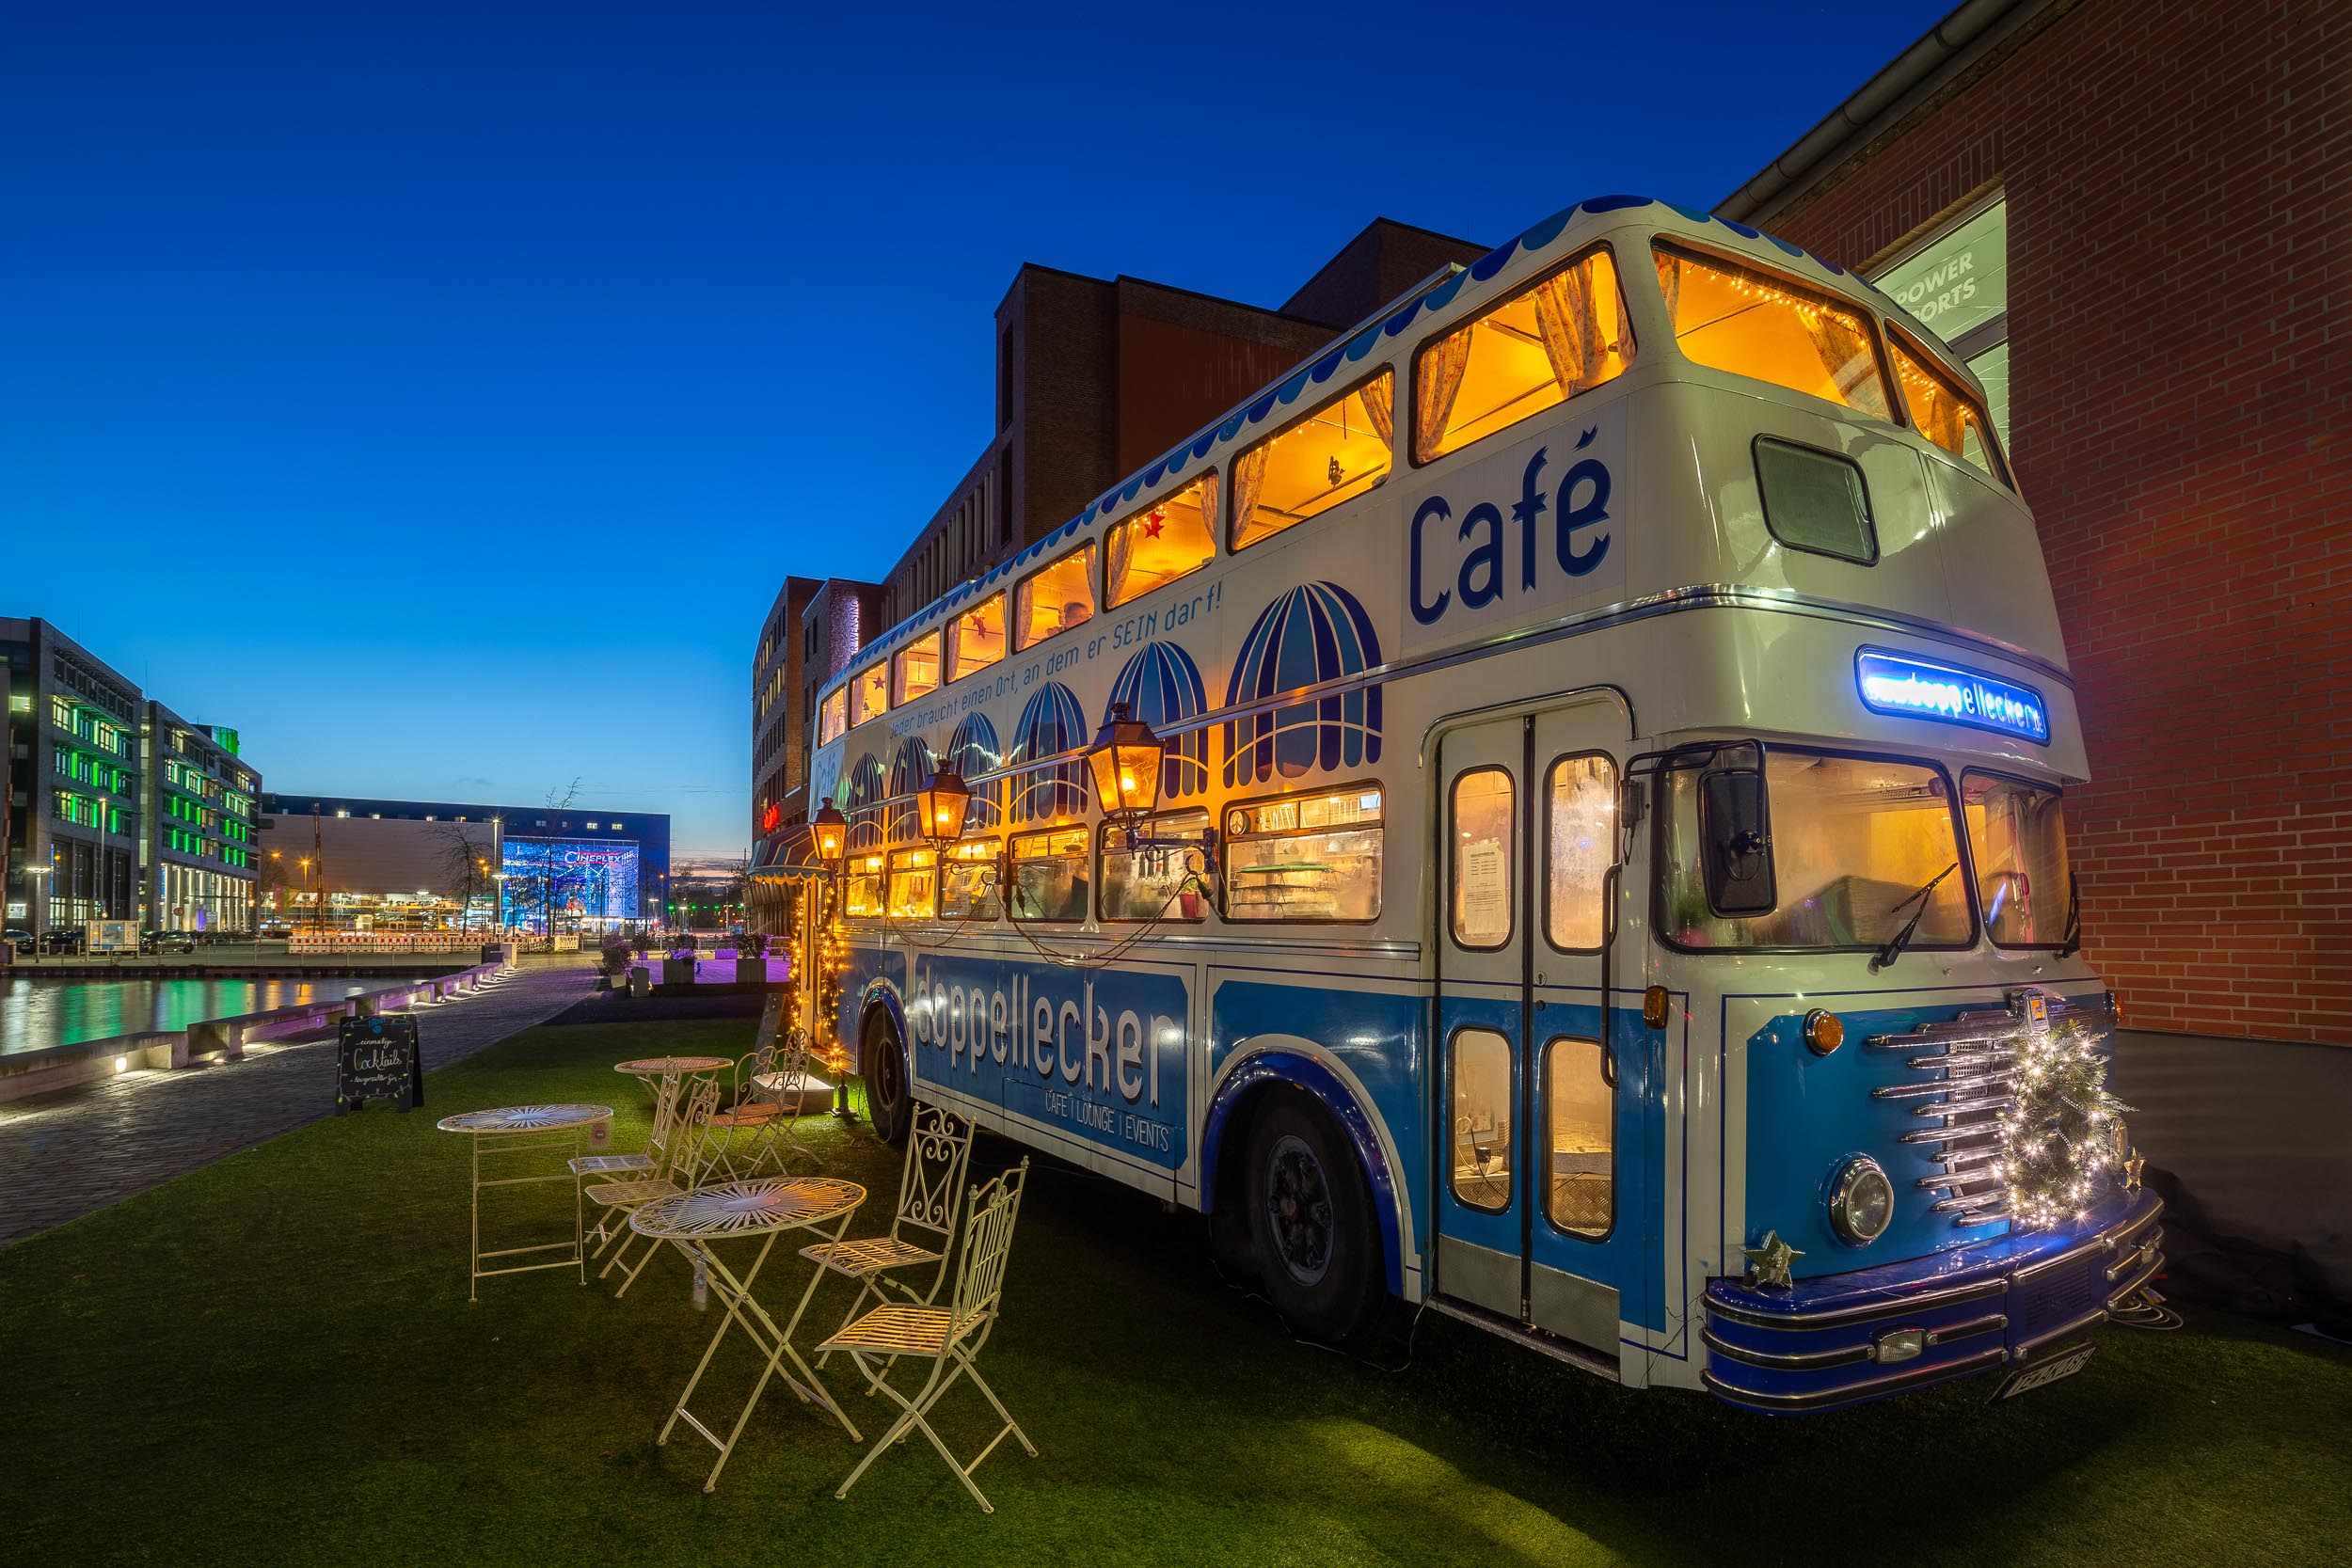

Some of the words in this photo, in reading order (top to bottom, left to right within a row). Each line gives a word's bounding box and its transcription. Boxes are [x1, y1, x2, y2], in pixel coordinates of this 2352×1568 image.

[1896, 251, 1975, 306] POWER
[1409, 421, 1613, 626] Café
[889, 715, 914, 740] Jeder
[916, 697, 958, 729] braucht
[961, 684, 993, 710] einen
[995, 671, 1018, 697] Ort,
[1023, 663, 1040, 686] an
[1046, 645, 1080, 676] dem
[1088, 635, 1107, 660] er
[1113, 610, 1158, 650] SEIN
[354, 1048, 403, 1071] Cocktails
[915, 962, 1179, 1109] doppellecker
[1076, 1100, 1115, 1134] LOUNGE
[1125, 1115, 1169, 1152] EVENTS
